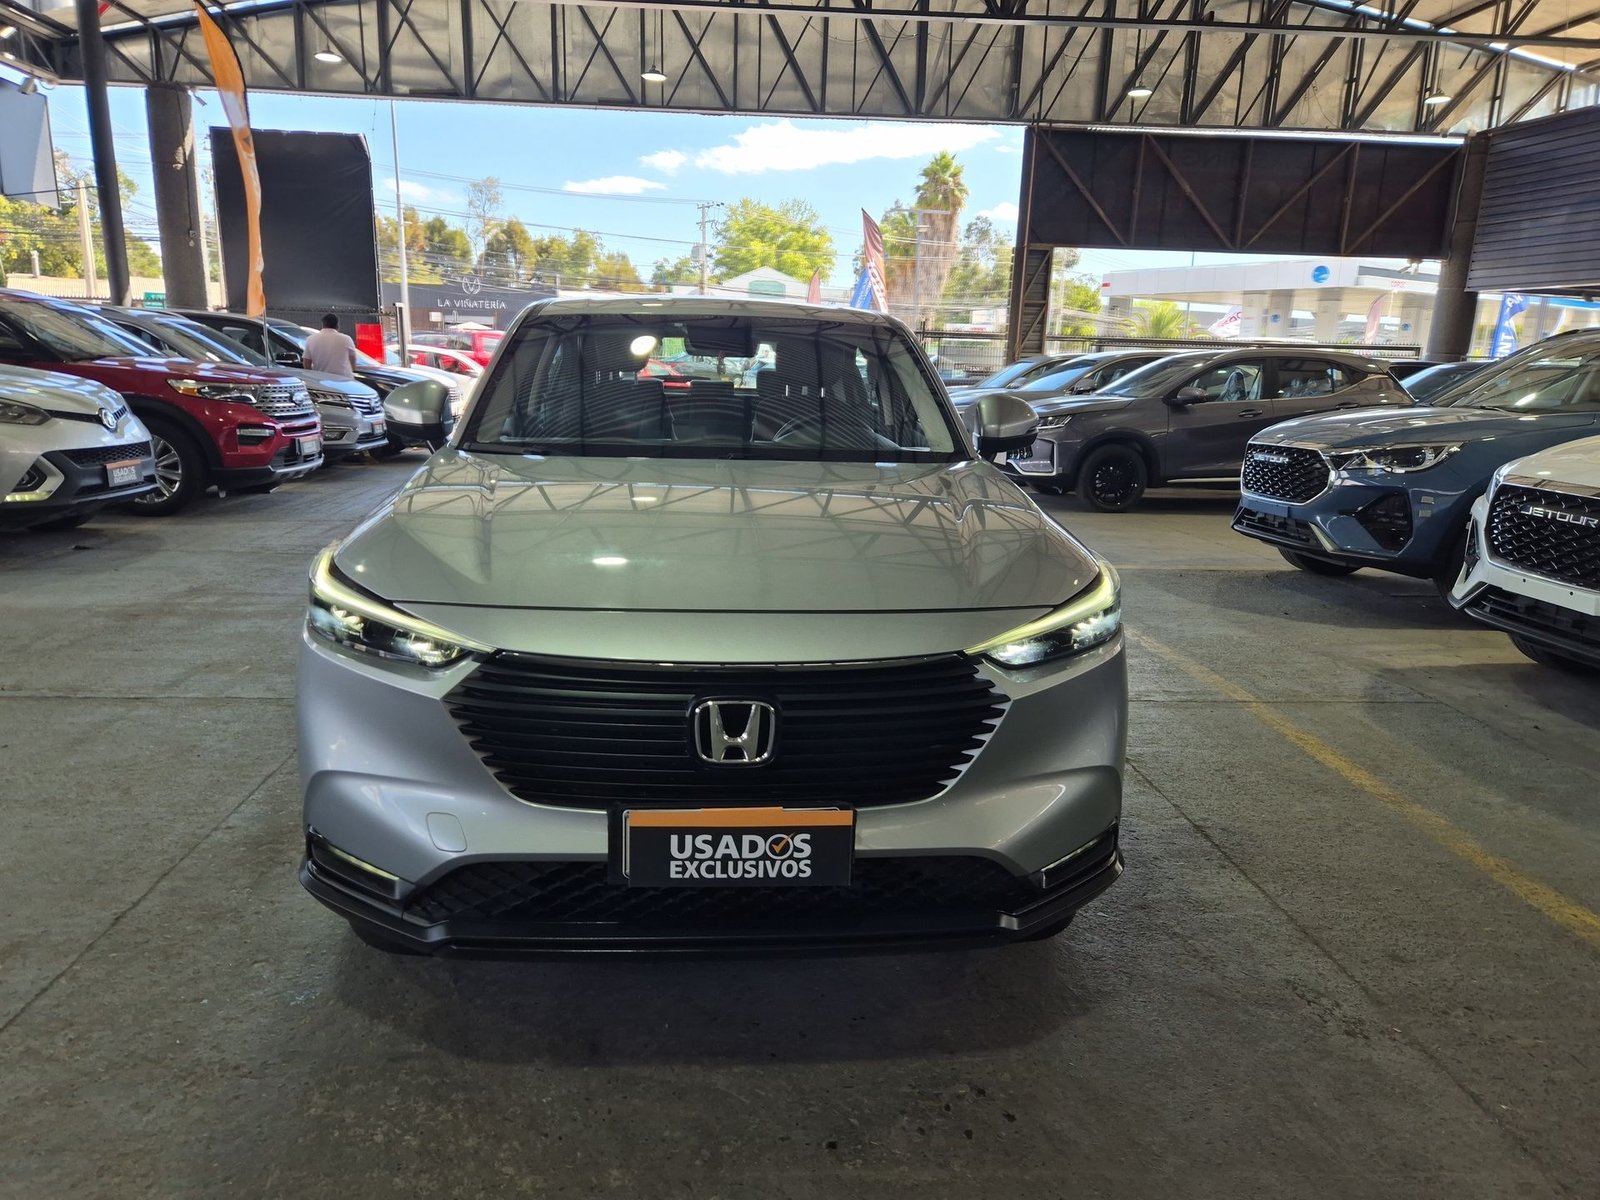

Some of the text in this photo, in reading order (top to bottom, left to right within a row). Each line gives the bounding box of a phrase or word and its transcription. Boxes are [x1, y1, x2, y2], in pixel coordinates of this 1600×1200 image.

[437, 298, 506, 310] LA VIÑATERÍA
[1254, 453, 1289, 464] JETOUR
[112, 466, 135, 477] USADOS
[1520, 506, 1599, 528] JETOUR
[670, 833, 811, 860] USADOS
[670, 860, 811, 879] EXCLUSIVOS
